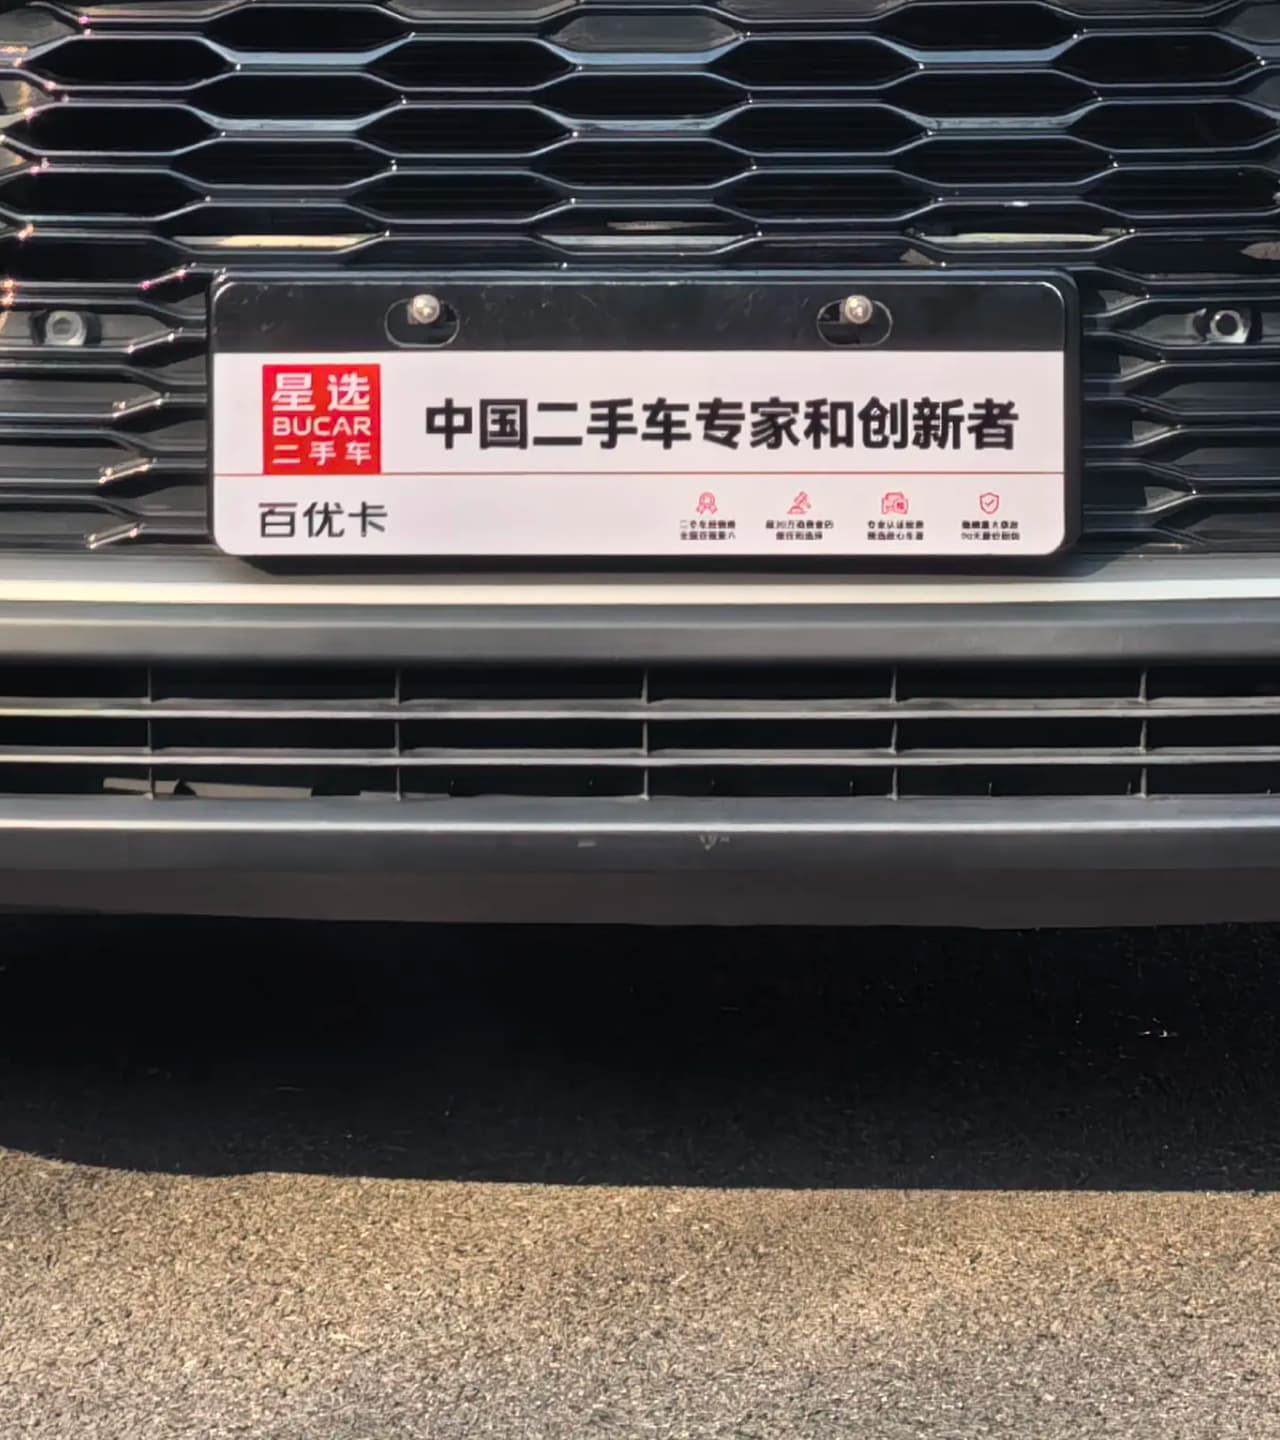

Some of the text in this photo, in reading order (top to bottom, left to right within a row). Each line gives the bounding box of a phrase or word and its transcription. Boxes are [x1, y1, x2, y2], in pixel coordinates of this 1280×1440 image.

[272, 372, 371, 412] 星选
[272, 416, 372, 437] BUCAR
[425, 396, 1020, 451] 中国二手车专家和创新者
[272, 439, 372, 467] 二手车
[258, 501, 388, 539] 百优卡
